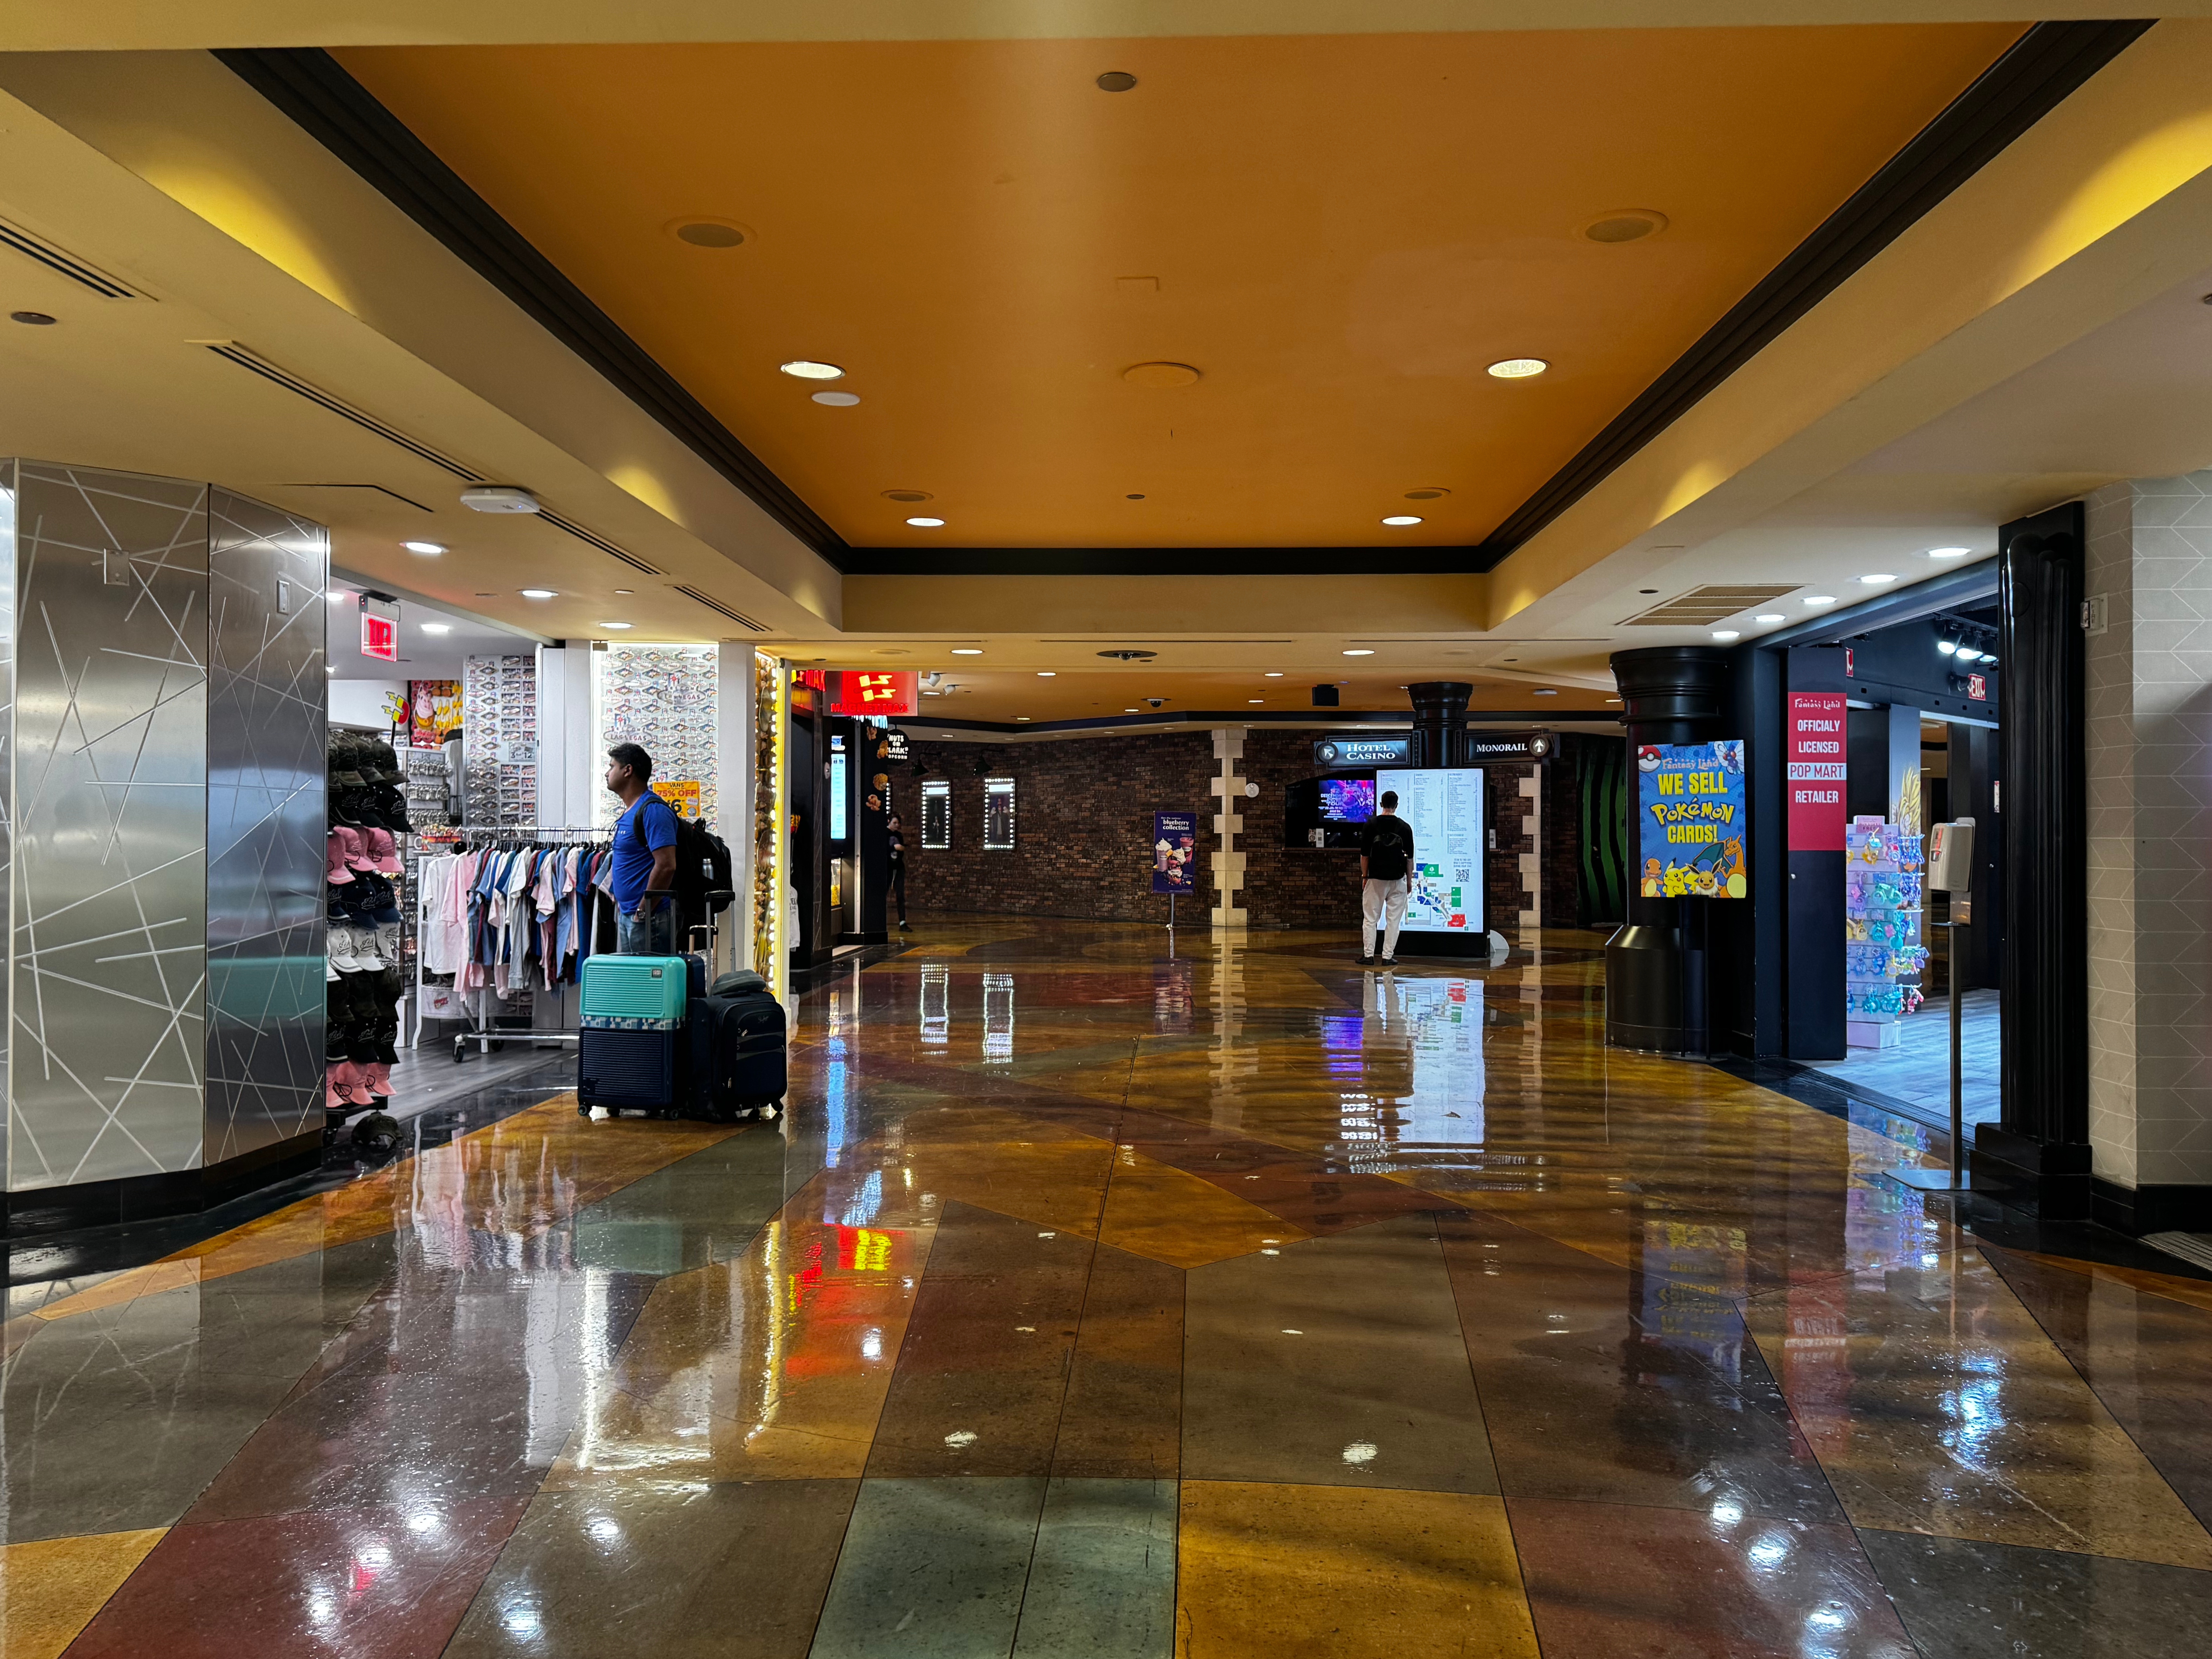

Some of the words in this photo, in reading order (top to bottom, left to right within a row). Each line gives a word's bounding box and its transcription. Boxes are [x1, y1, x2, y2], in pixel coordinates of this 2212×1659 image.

[1971, 677, 1983, 698] EXIT
[831, 703, 880, 713] MAGNET
[882, 703, 908, 713] MAX
[1795, 698, 1821, 709] Fantasy
[1824, 700, 1840, 710] Land
[1797, 720, 1840, 732] OFFICIALY
[1477, 743, 1528, 752] MONORAIL
[1798, 741, 1839, 753] LICENSED
[1662, 758, 1696, 769] Fantasy
[1698, 758, 1719, 770] Land
[1790, 764, 1811, 778] POP
[1814, 764, 1844, 778] MART
[1658, 773, 1684, 795] WE
[1688, 771, 1728, 794] SELL
[1795, 790, 1839, 803] RETAILER
[1668, 825, 1718, 843] CARDS!
